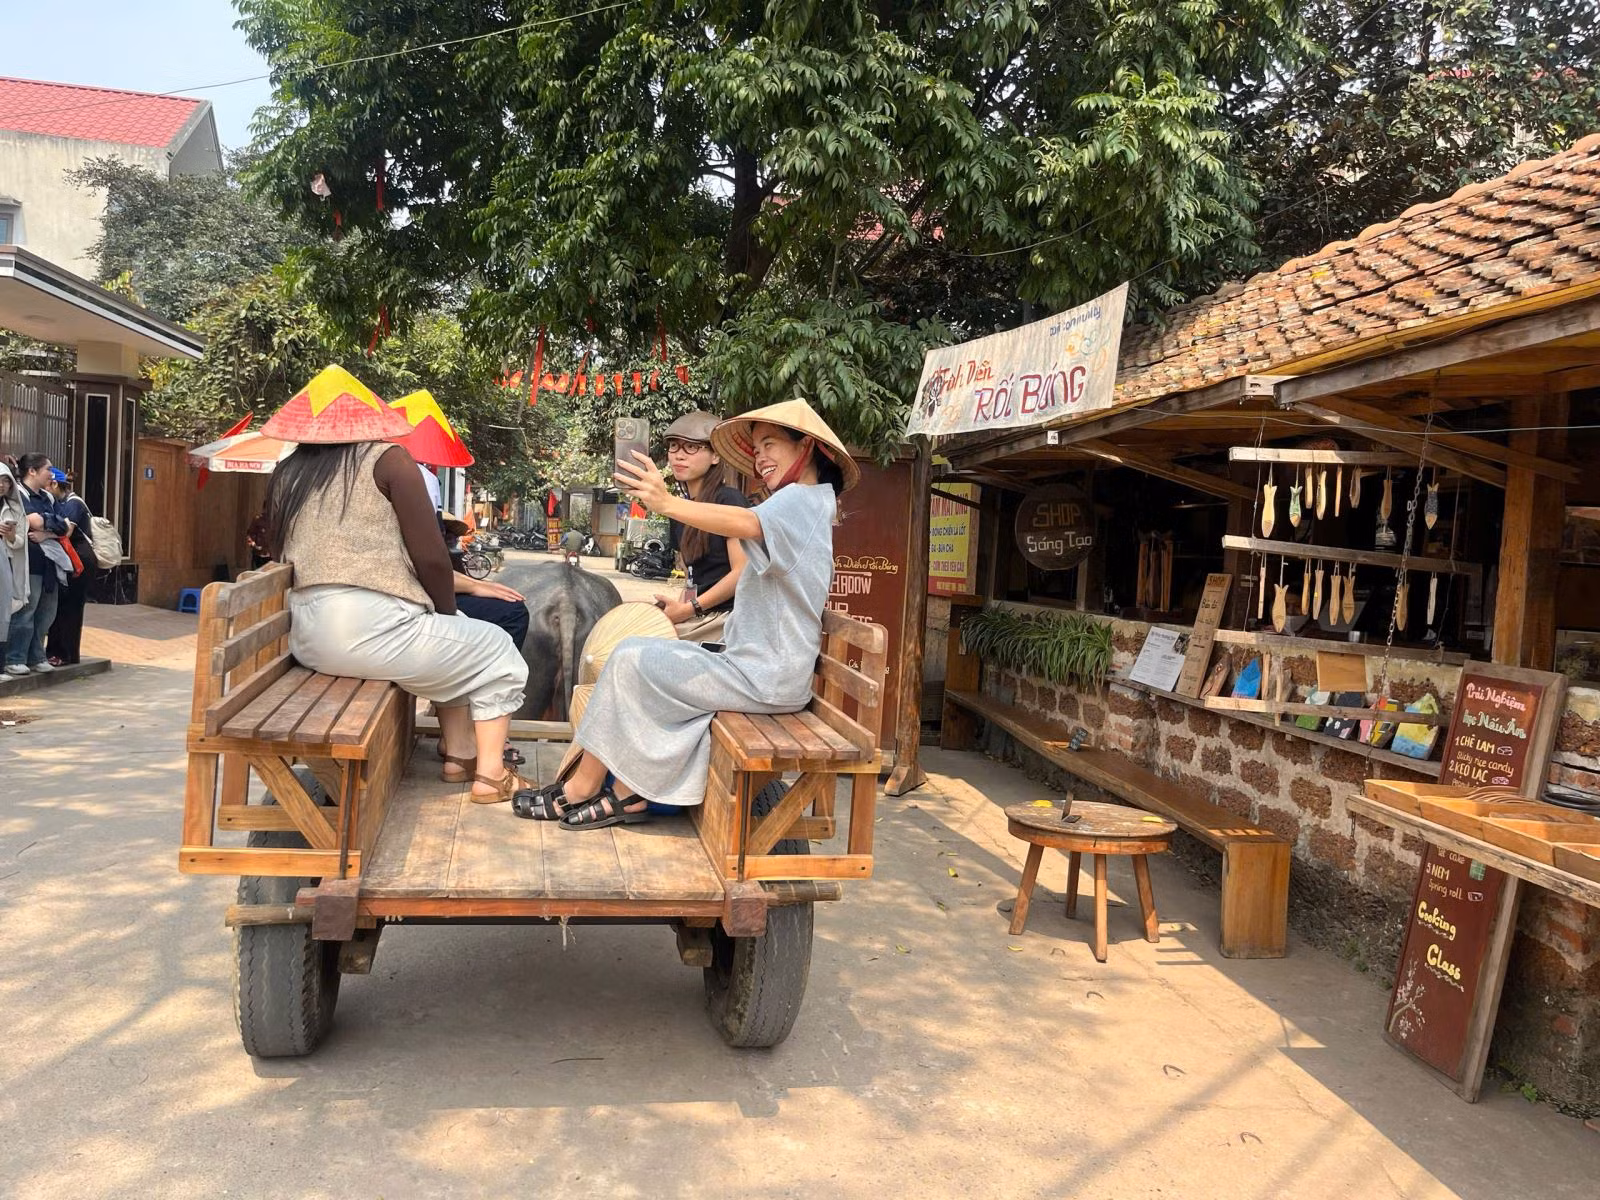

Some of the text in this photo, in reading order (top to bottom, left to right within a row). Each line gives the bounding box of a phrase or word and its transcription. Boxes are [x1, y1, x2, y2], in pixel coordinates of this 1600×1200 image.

[1033, 503, 1080, 527] SHOP
[1027, 531, 1092, 555] Sáng Tạo
[1455, 736, 1460, 746] 1
[1476, 739, 1495, 754] LAM
[1449, 760, 1455, 771] 2
[1475, 756, 1487, 768] rice
[1488, 761, 1514, 777] candy
[1426, 862, 1450, 881] 5 NEM
[1449, 887, 1463, 900] roll
[1418, 901, 1456, 941] Cooking
[1427, 944, 1461, 979] Class
